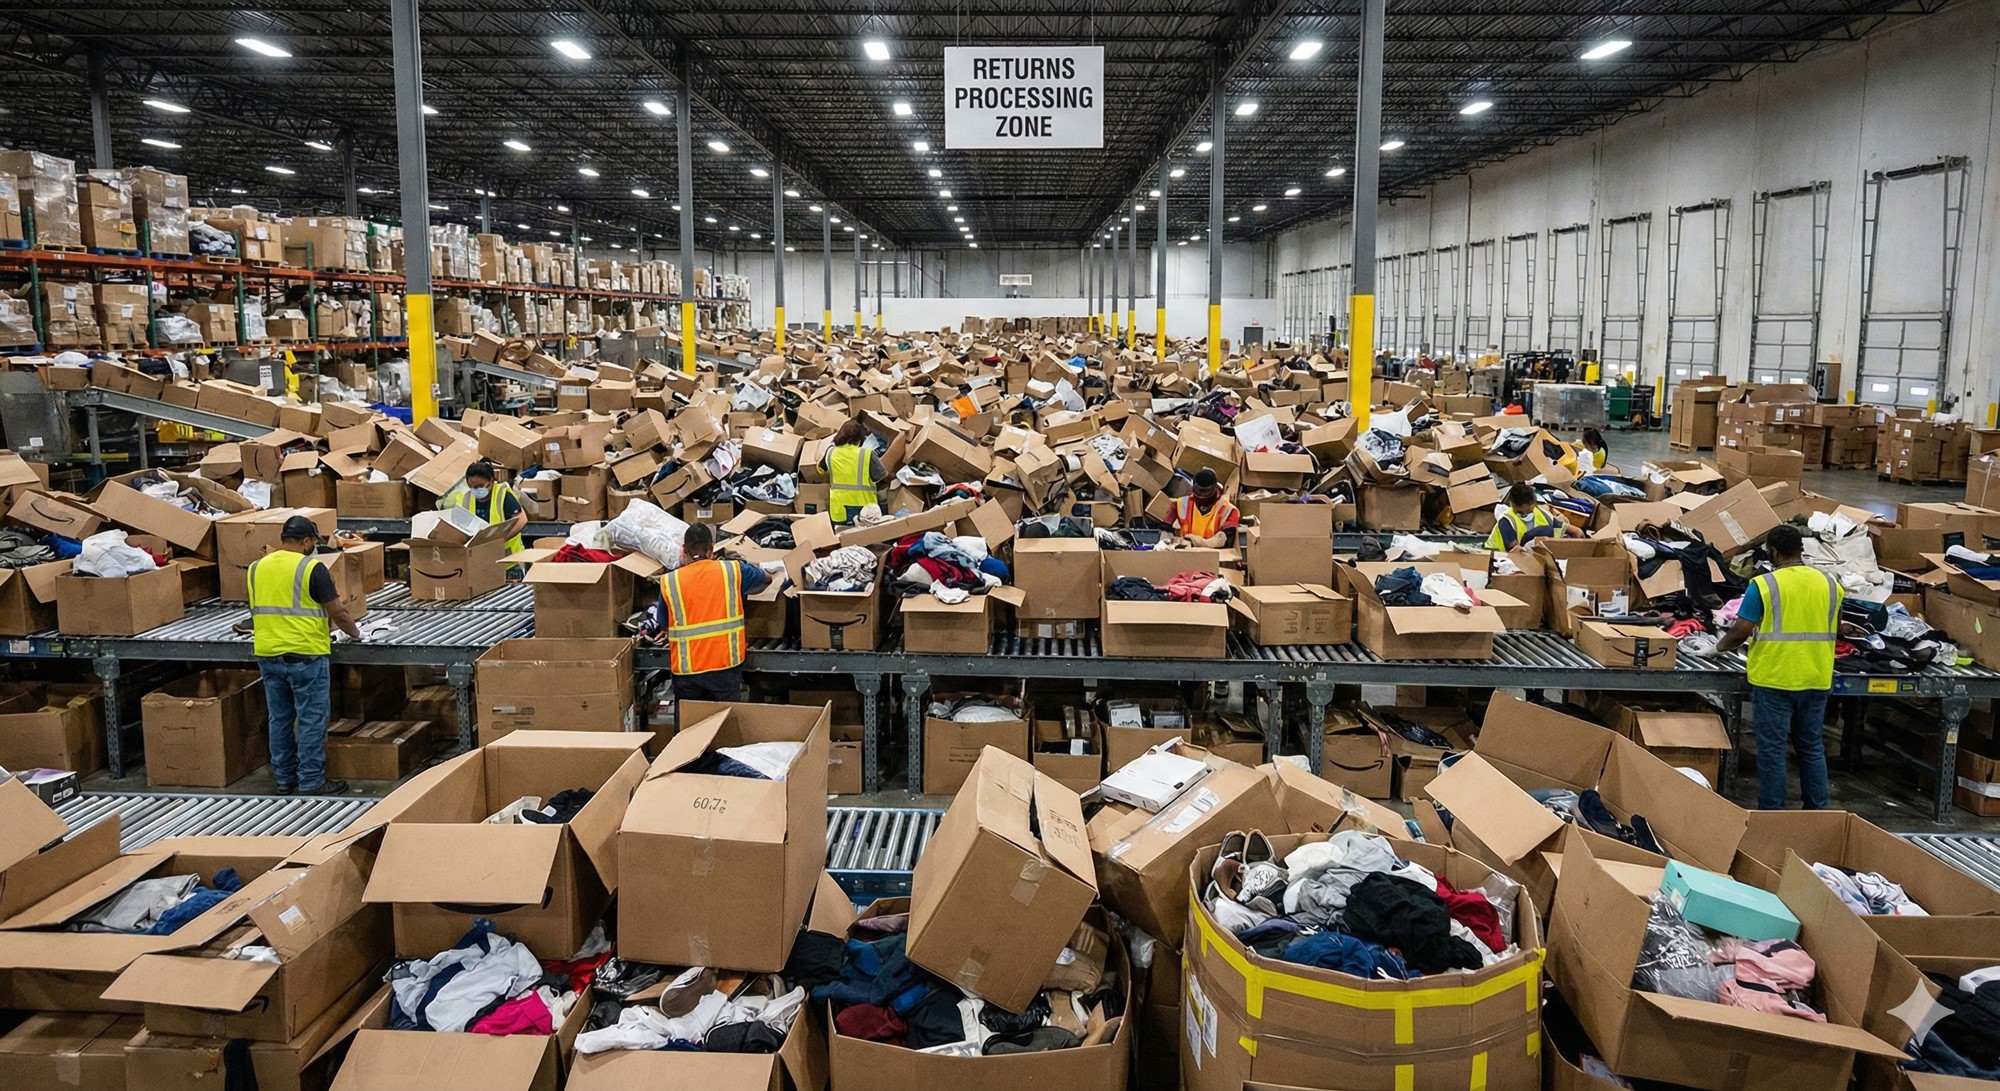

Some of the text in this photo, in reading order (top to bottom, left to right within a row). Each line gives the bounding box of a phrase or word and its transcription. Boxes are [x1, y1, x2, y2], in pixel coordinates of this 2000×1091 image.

[973, 57, 1075, 80] RETURNS
[955, 86, 1093, 109] PROCESSING
[995, 115, 1052, 138] ZONE
